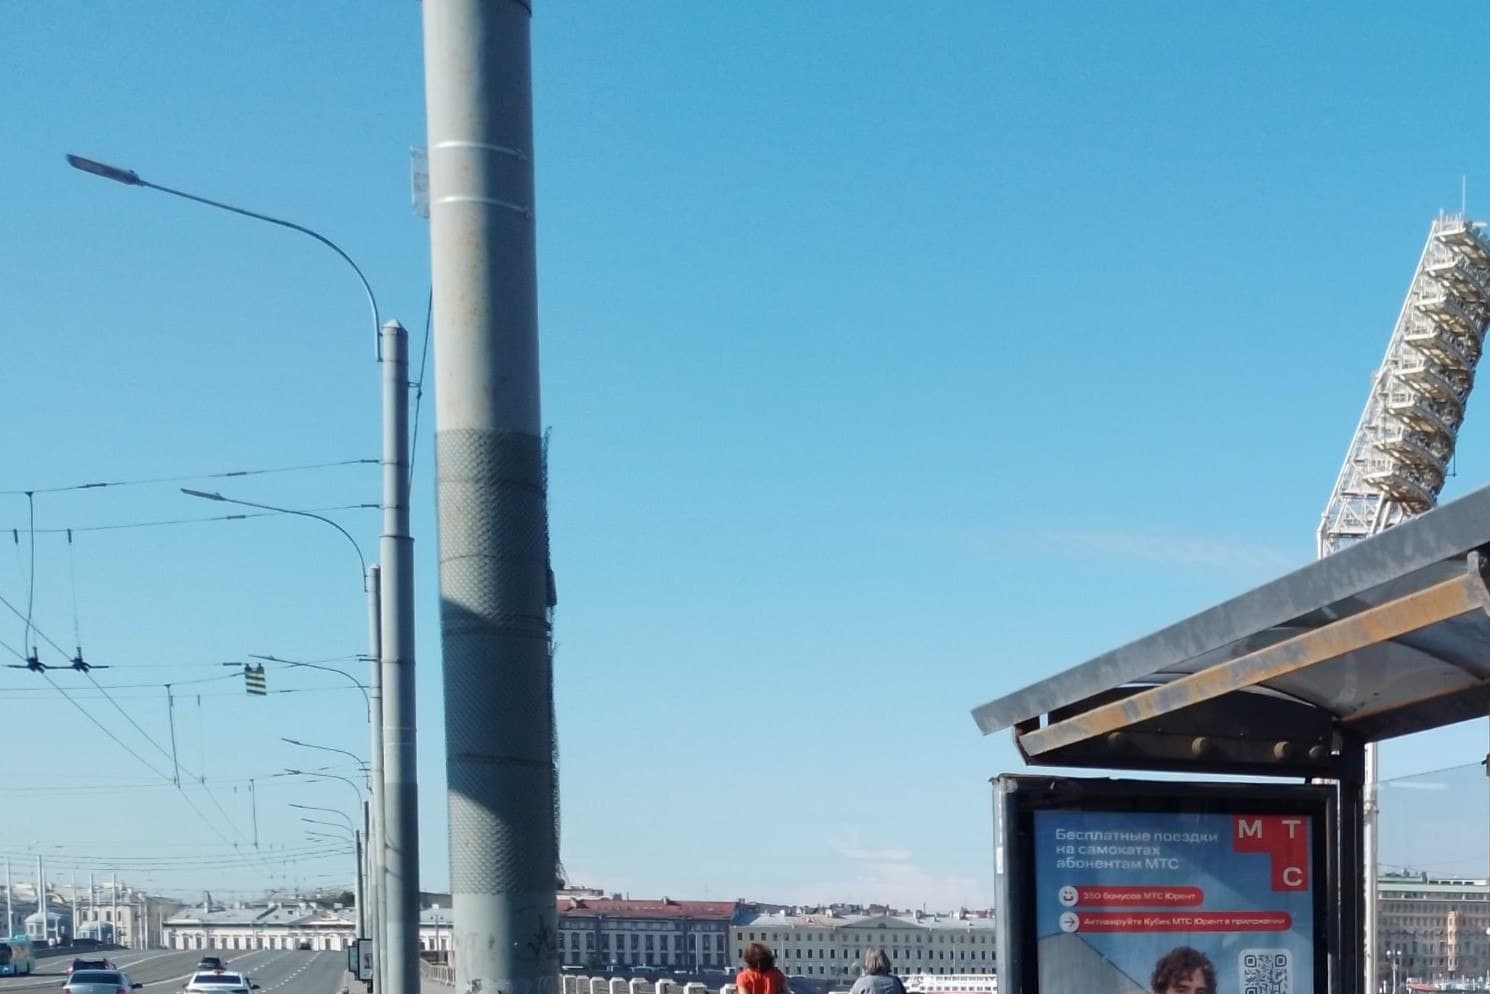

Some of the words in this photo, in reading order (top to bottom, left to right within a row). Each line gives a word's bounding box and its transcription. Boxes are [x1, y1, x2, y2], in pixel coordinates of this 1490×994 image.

[1055, 828, 1151, 841] Бесплатные
[1153, 832, 1218, 844] поездки
[1056, 845, 1075, 855] на
[1078, 846, 1160, 856] самокатах
[1056, 857, 1143, 869] абонентам
[1145, 858, 1180, 869] МТС
